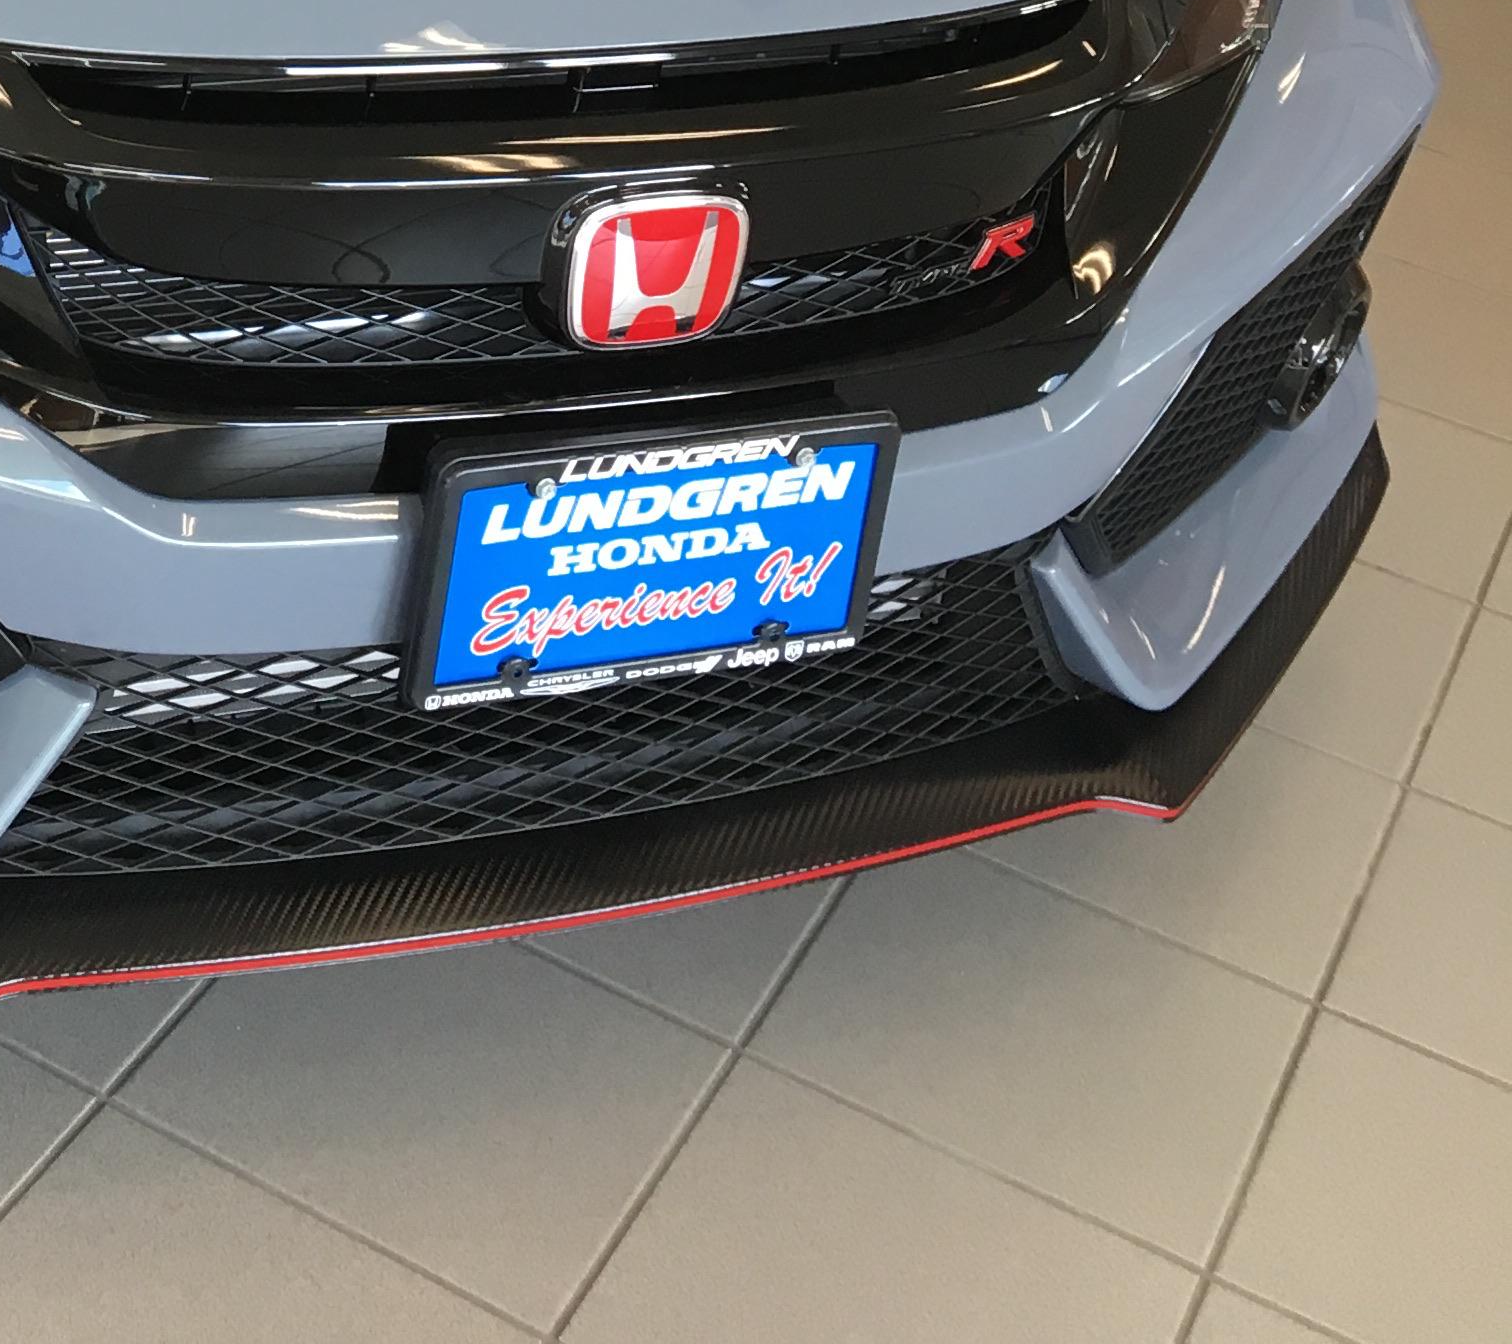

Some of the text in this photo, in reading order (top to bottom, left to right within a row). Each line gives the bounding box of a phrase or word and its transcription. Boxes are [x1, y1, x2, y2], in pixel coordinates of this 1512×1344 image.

[968, 213, 1035, 272] R
[559, 435, 800, 484] LUNDGREN
[481, 460, 856, 545] LUNDGREN
[547, 522, 770, 576] HONDA
[470, 541, 843, 656] Experience It!
[442, 687, 515, 706] HONDA
[527, 669, 615, 687] CHRYSLER
[727, 646, 780, 669] Jeep
[806, 637, 856, 653] RAM
